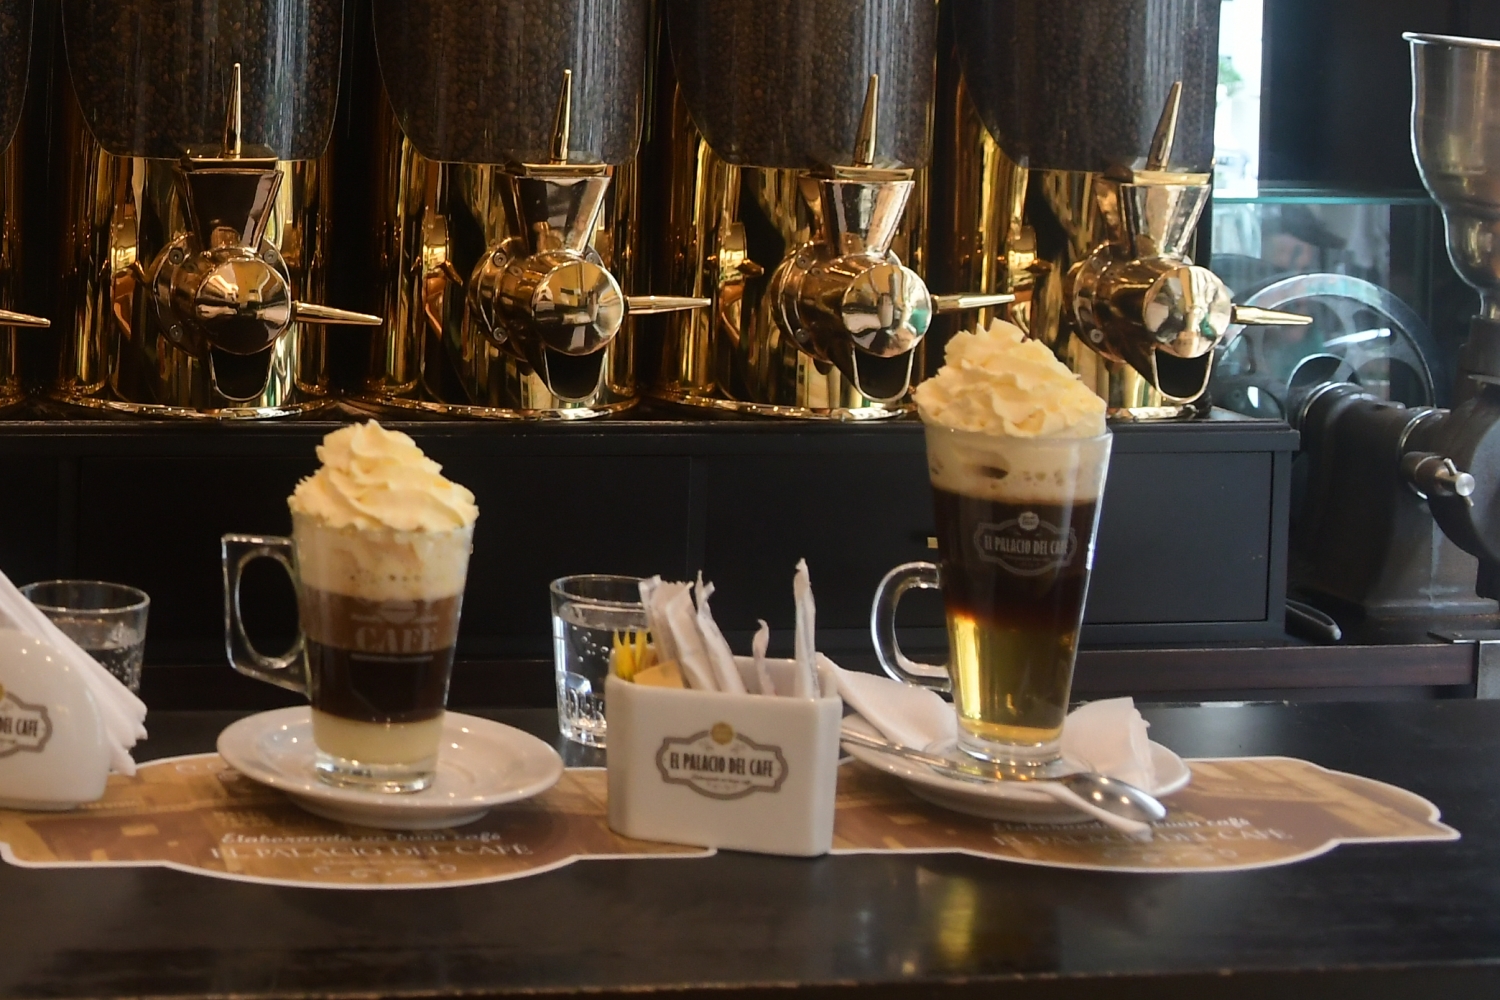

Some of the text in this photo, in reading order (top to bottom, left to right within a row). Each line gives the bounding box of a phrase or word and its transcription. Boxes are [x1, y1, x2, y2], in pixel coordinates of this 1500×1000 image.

[995, 537, 1031, 555] PALACIO
[1033, 540, 1048, 555] DEL
[670, 752, 680, 770] EL
[683, 753, 726, 773] PALACIO
[729, 757, 746, 775] DEL
[255, 846, 383, 859] PALACIO
